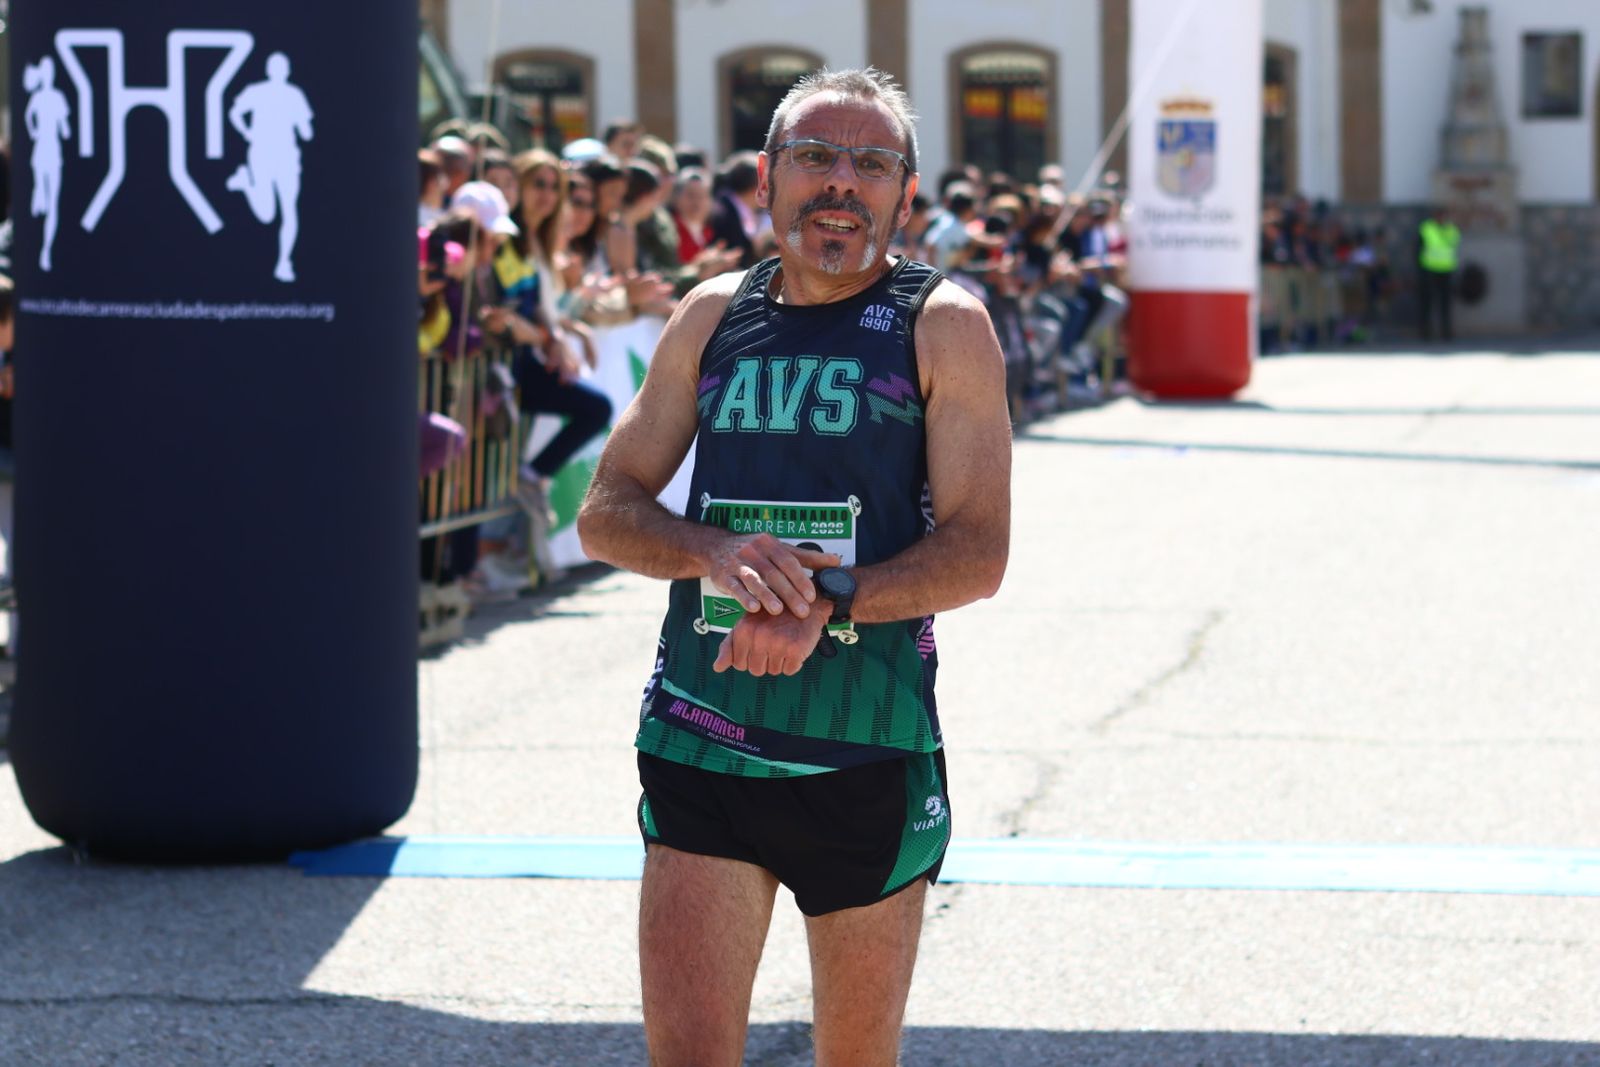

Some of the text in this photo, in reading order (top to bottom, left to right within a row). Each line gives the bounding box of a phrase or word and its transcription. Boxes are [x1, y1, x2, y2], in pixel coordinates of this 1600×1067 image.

[863, 304, 896, 319] AVS
[859, 315, 892, 332] 1990
[711, 355, 864, 437] AVS
[734, 507, 761, 520] SAN
[773, 508, 849, 522] FERNANDO
[733, 519, 844, 535] CARRERA 2026
[669, 700, 745, 741] SALAMANCA
